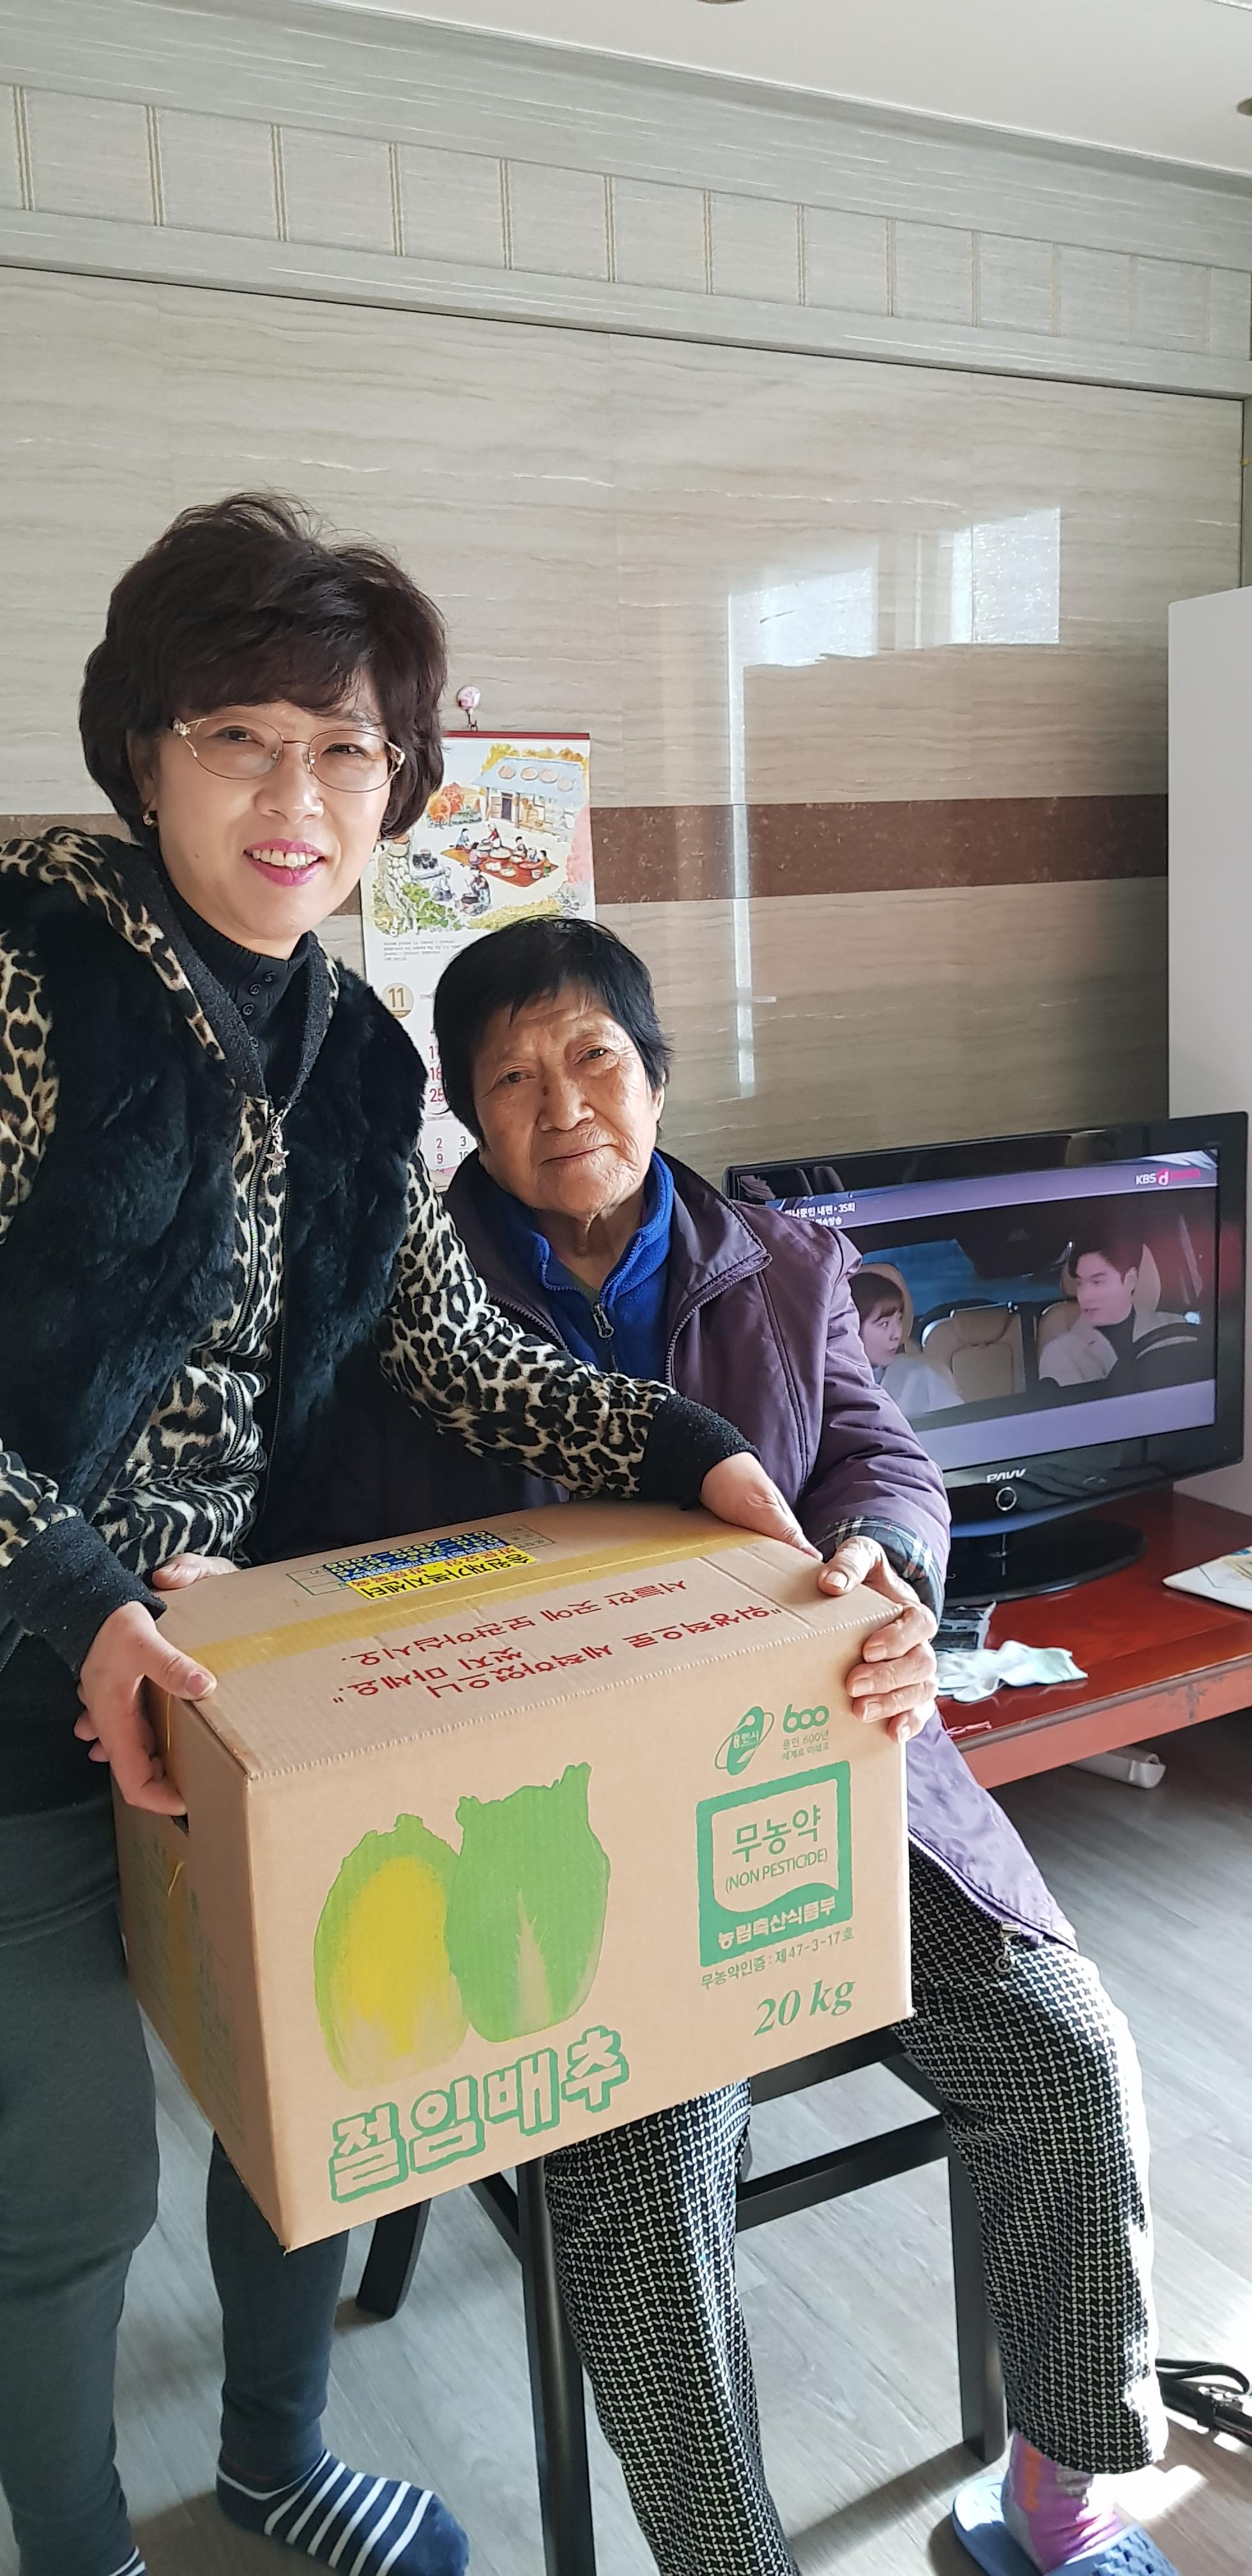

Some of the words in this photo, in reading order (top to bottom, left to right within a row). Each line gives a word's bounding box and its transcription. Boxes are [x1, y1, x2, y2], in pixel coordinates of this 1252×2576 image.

[388, 987, 404, 1008] 11
[429, 1088, 445, 1103] 25
[436, 1138, 443, 1149] 2
[460, 1136, 467, 1147] 3
[436, 1154, 443, 1164] 9
[1135, 1173, 1157, 1185] KBS
[986, 1468, 1027, 1483] PAVV
[360, 1554, 528, 1597] 송원재가복지센터
[604, 1580, 687, 1606] 서늘한
[540, 1600, 602, 1622] 곳에
[341, 1616, 536, 1666] 보관하십시오.
[426, 1644, 613, 1698] 세척하였으니
[458, 1647, 523, 1670] 씻지
[731, 1804, 821, 1864] 무농약
[725, 1865, 760, 1894] (NON
[762, 1848, 828, 1880] PESTICIDE)
[718, 1896, 836, 1949] 농림축산식품부
[754, 1989, 801, 2037] 20
[809, 1979, 855, 2017] kg
[328, 2025, 630, 2204] 절임배추
